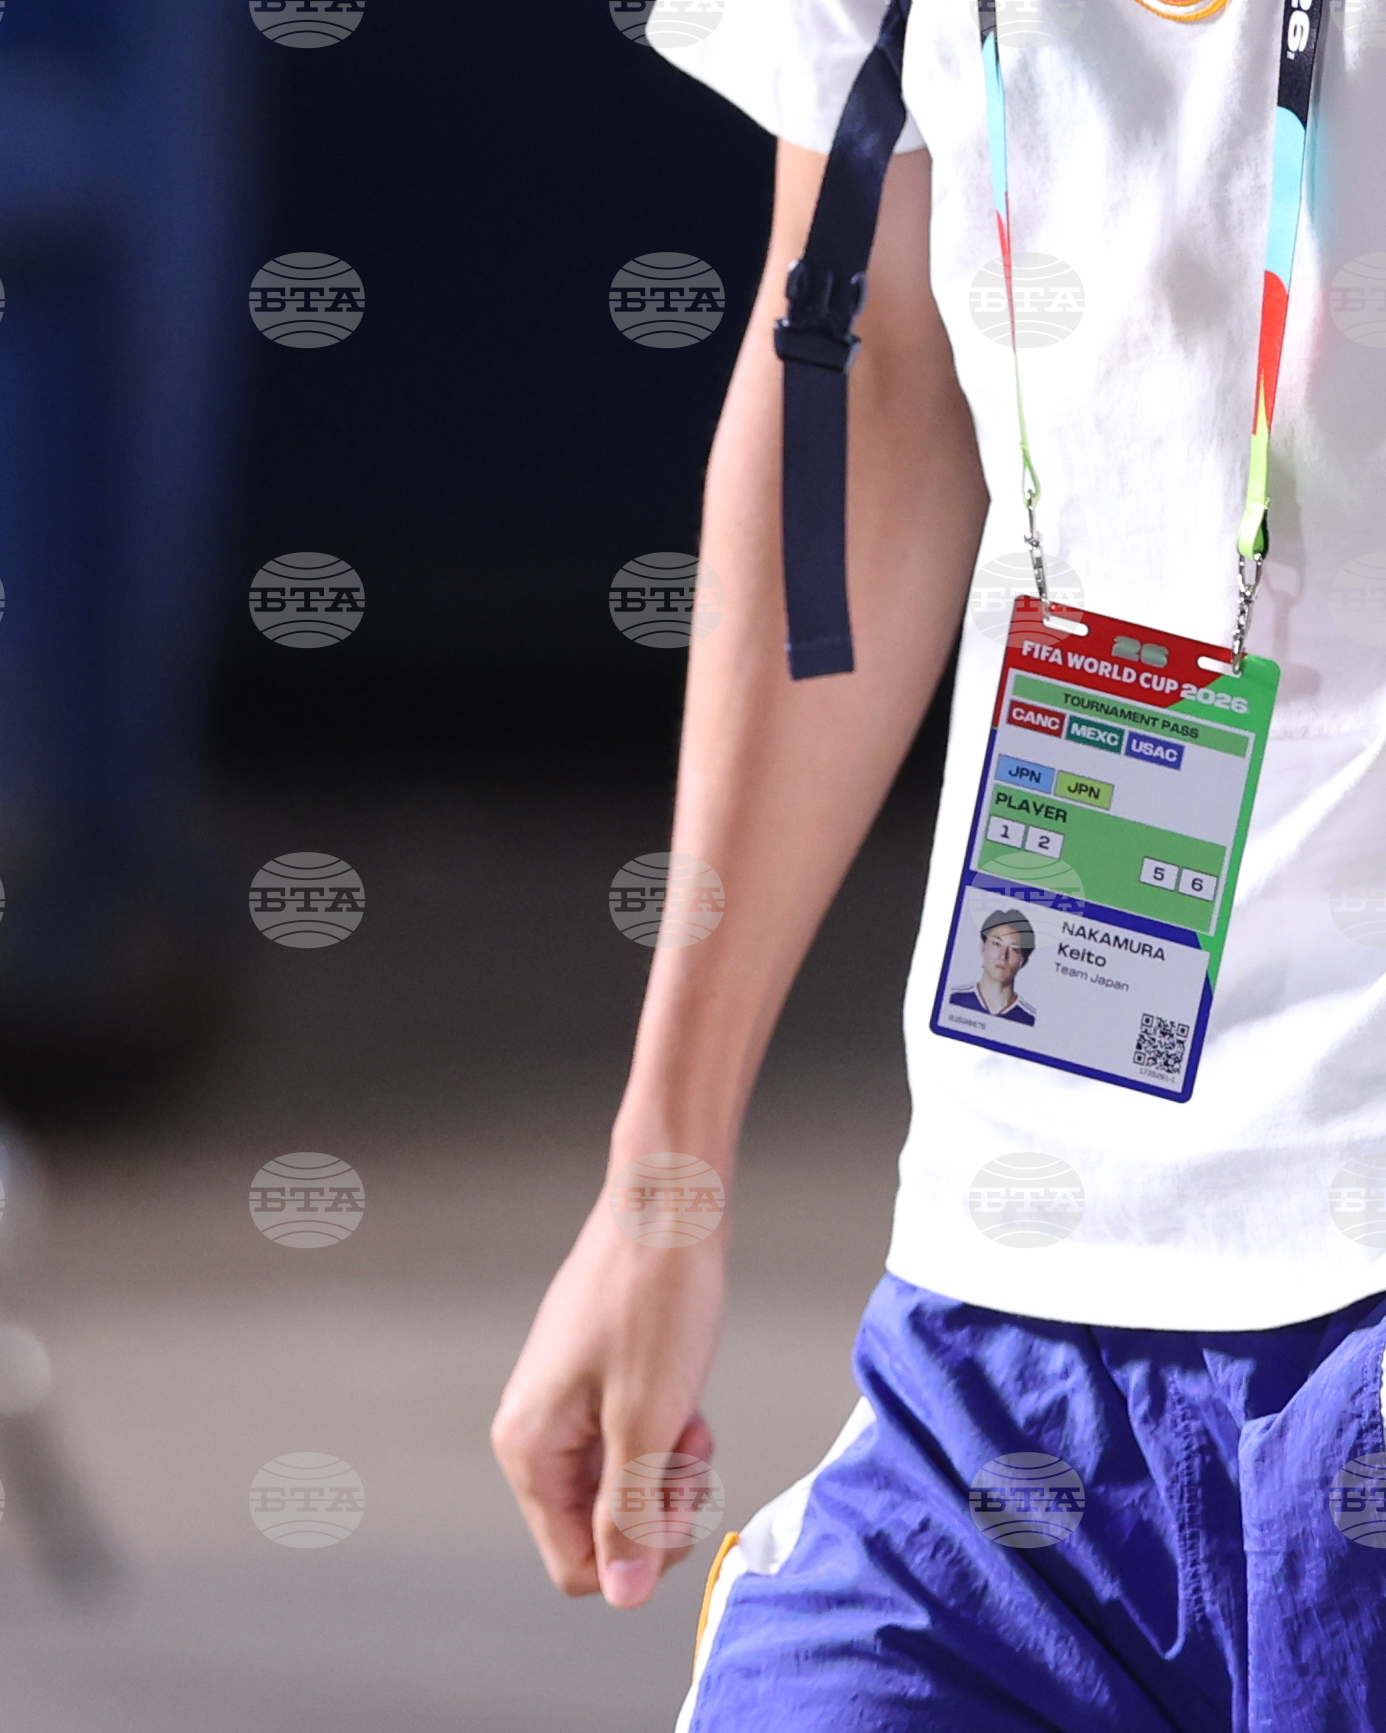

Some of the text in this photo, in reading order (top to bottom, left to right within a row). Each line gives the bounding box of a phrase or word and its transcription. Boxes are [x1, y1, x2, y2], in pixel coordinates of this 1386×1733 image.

[1021, 640, 1249, 714] FIFA WORLD CUP 2026
[1063, 692, 1199, 739] TOURNAMENT PASS
[1012, 707, 1178, 762] CANC MEXC USAC
[1008, 766, 1101, 800] JPN JPN
[995, 792, 1068, 823] PLAYER
[1001, 825, 1050, 850] 1 2
[1153, 867, 1204, 892] 5 6
[1057, 942, 1107, 967] Keito
[1062, 921, 1166, 961] NAKAMURA
[1055, 962, 1129, 992] Team Japan
